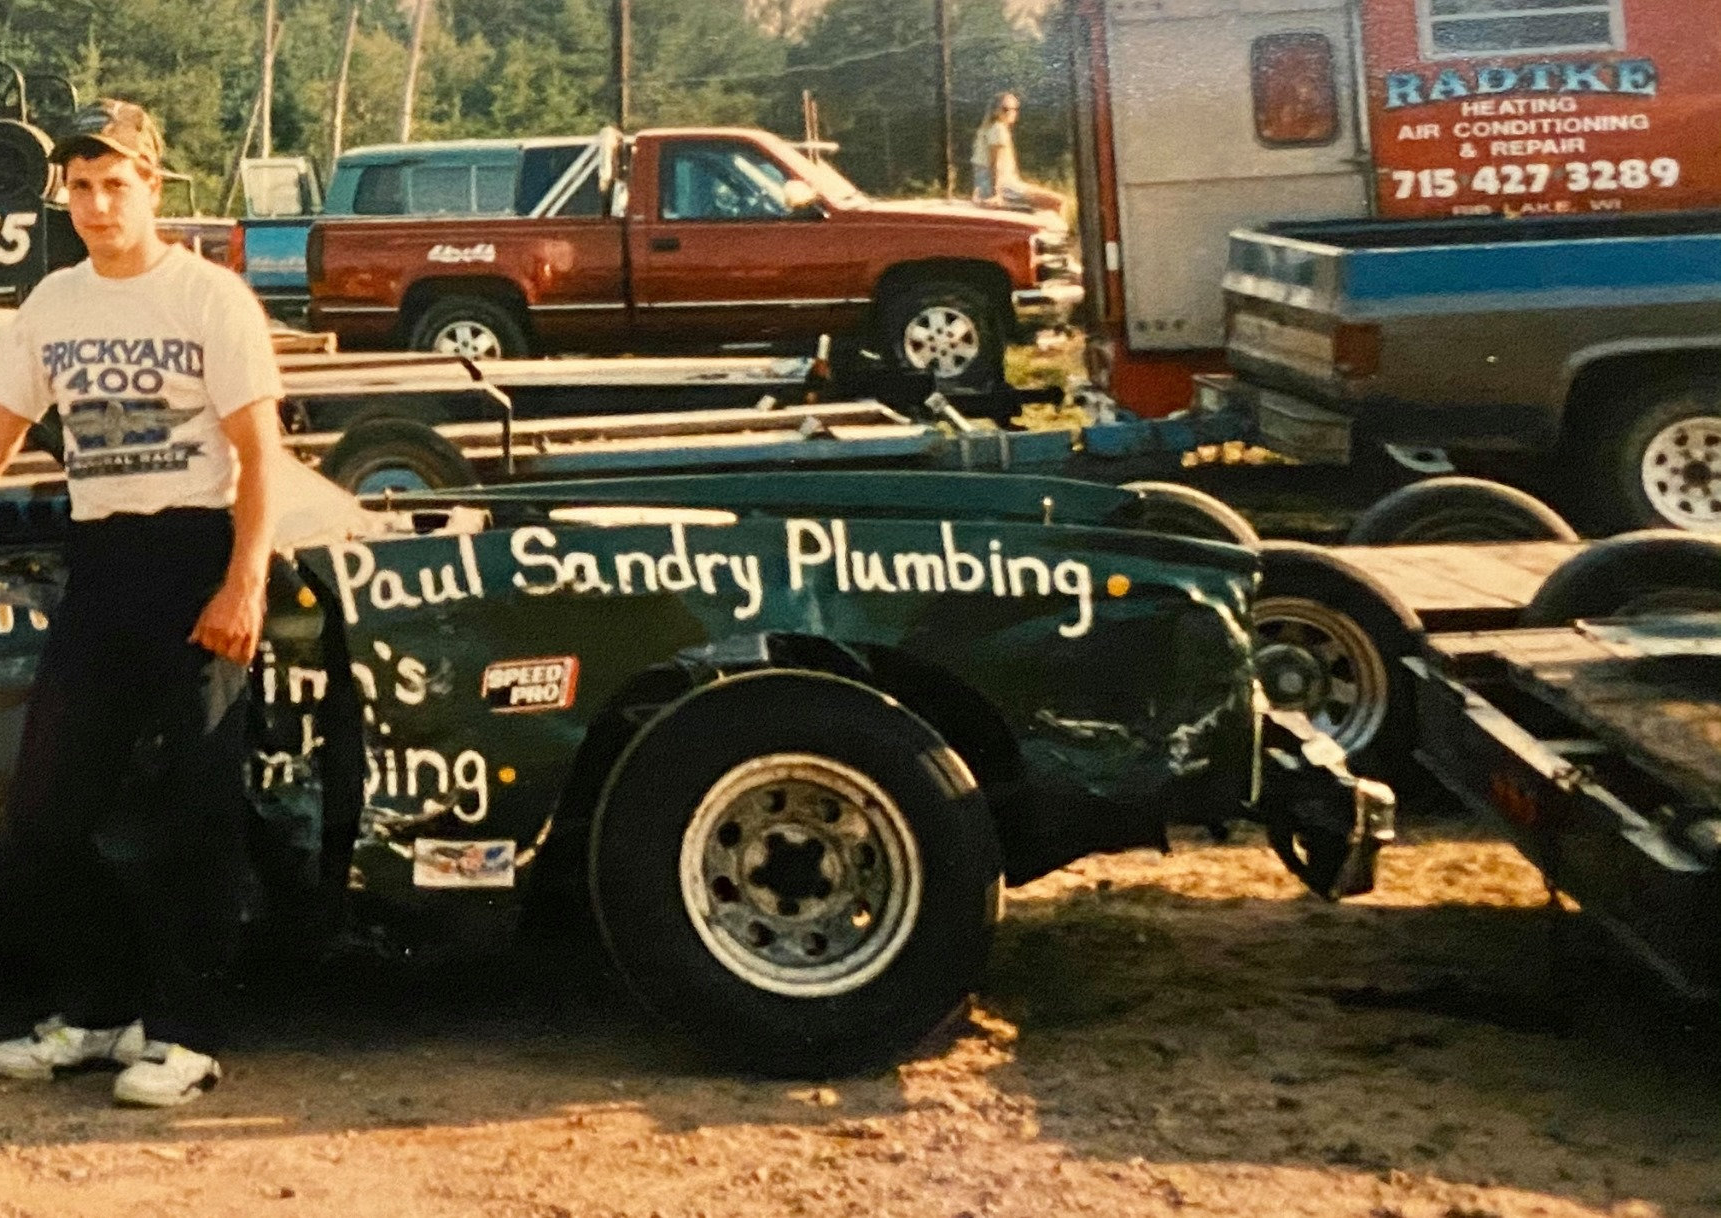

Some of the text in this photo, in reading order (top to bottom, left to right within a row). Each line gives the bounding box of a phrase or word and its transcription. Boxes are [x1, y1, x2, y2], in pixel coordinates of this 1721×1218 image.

[1384, 58, 1659, 109] RADTKE
[1461, 96, 1579, 118] HEATING
[1397, 113, 1651, 142] AIR CONDITIONING
[1459, 137, 1587, 159] & REPAIR
[1392, 156, 1680, 200] 715 427 3289
[65, 367, 164, 395] 400
[329, 518, 1093, 638] Paul Sandry Plumbing
[487, 664, 563, 689] SPEED
[509, 683, 560, 706] PRO
